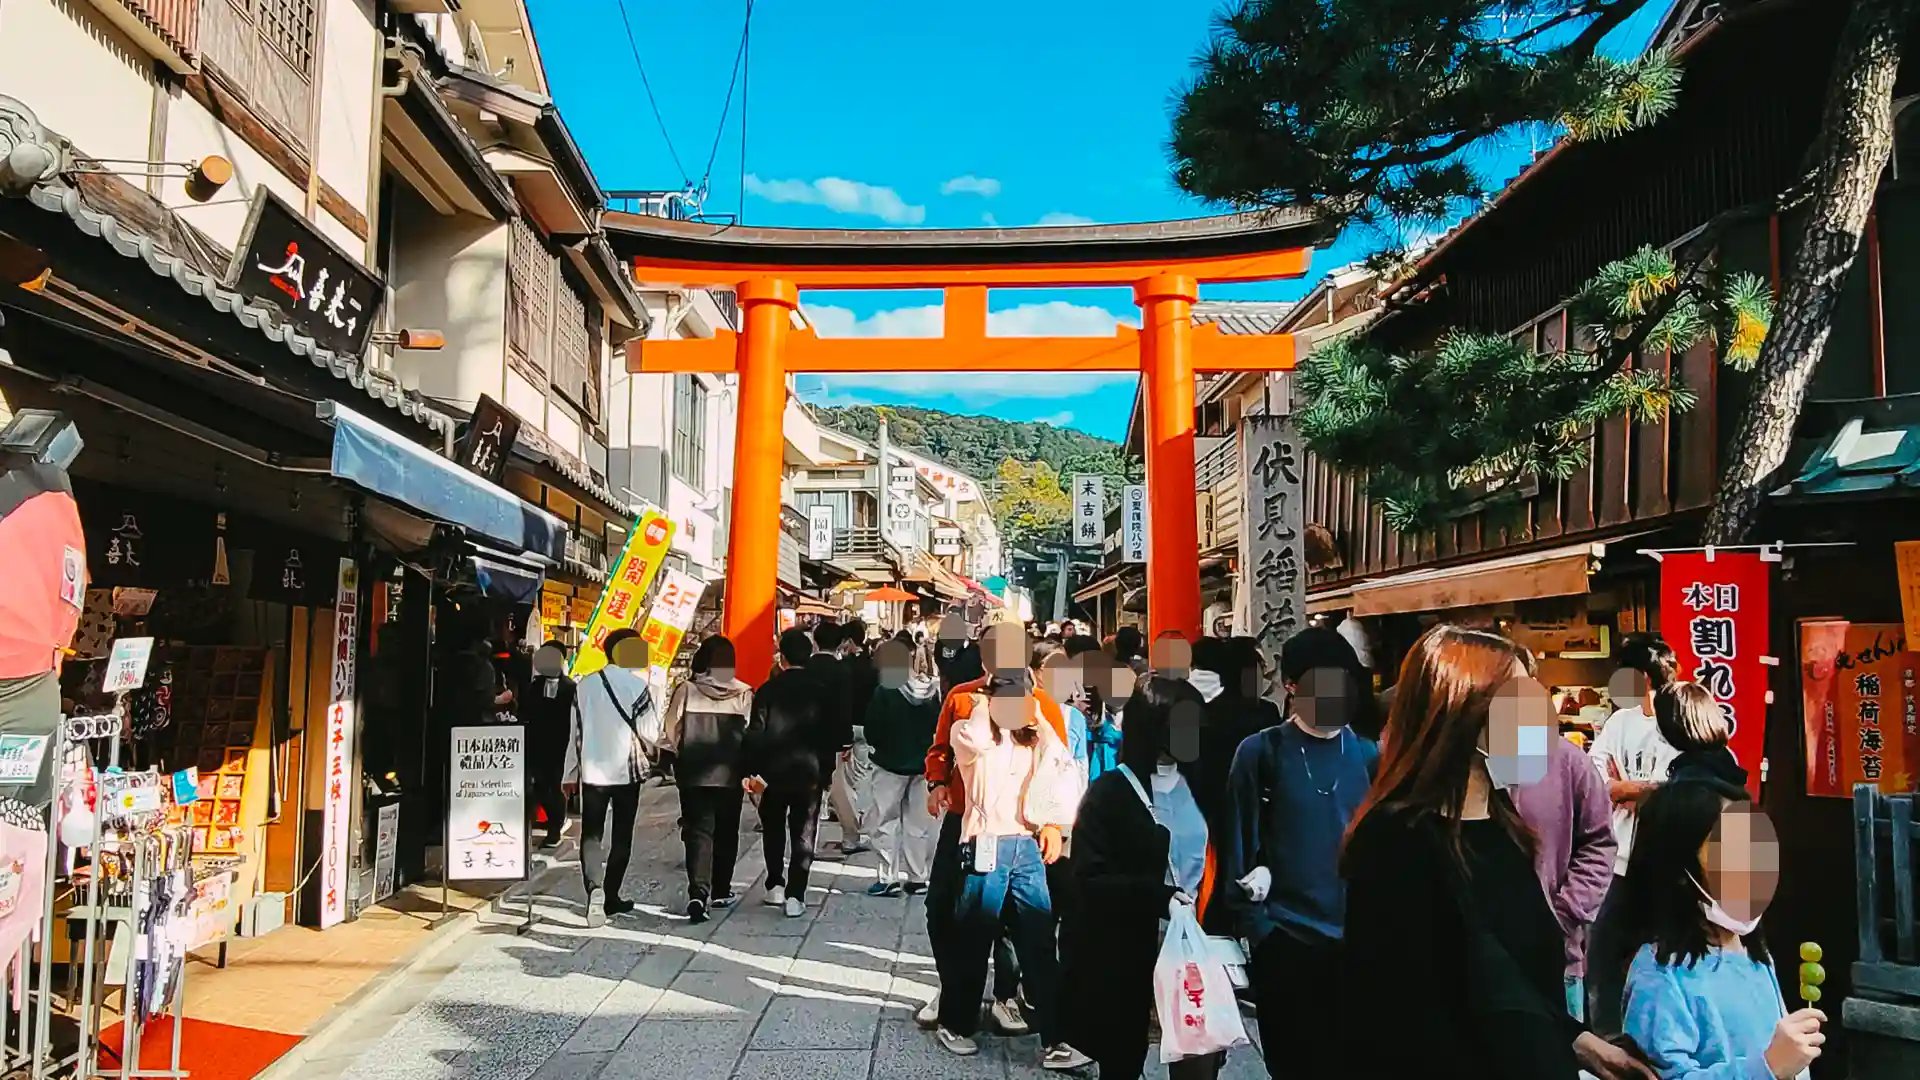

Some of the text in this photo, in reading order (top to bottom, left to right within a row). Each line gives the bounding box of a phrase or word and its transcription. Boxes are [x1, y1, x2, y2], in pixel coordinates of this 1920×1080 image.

[1682, 582, 1739, 611] 本日
[1855, 673, 1884, 780] 稲荷海苔
